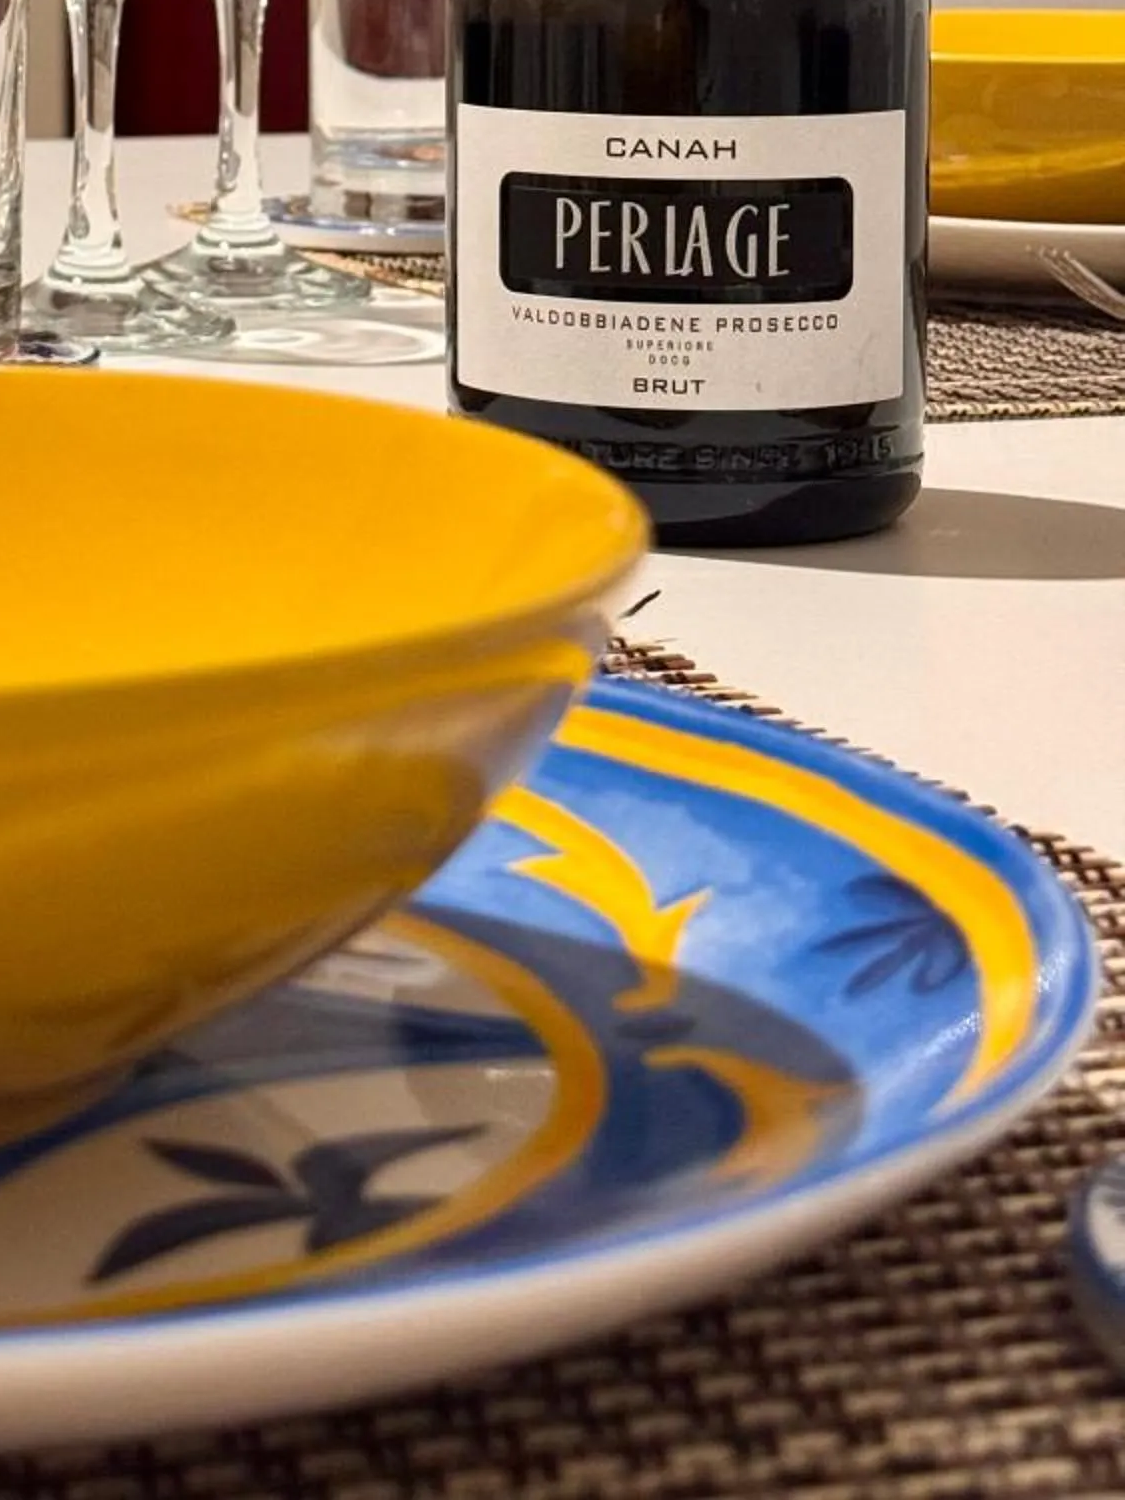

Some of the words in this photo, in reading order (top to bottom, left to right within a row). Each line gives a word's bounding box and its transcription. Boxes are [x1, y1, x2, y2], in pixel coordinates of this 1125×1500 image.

[606, 137, 737, 160] CANAH
[555, 197, 791, 279] PERLAGE
[512, 306, 702, 333] VALDOBBIADENE
[716, 313, 839, 332] PROSECCO
[626, 338, 714, 352] SUPERIORE
[648, 353, 691, 367] DOCG
[633, 377, 706, 395] BRUT
